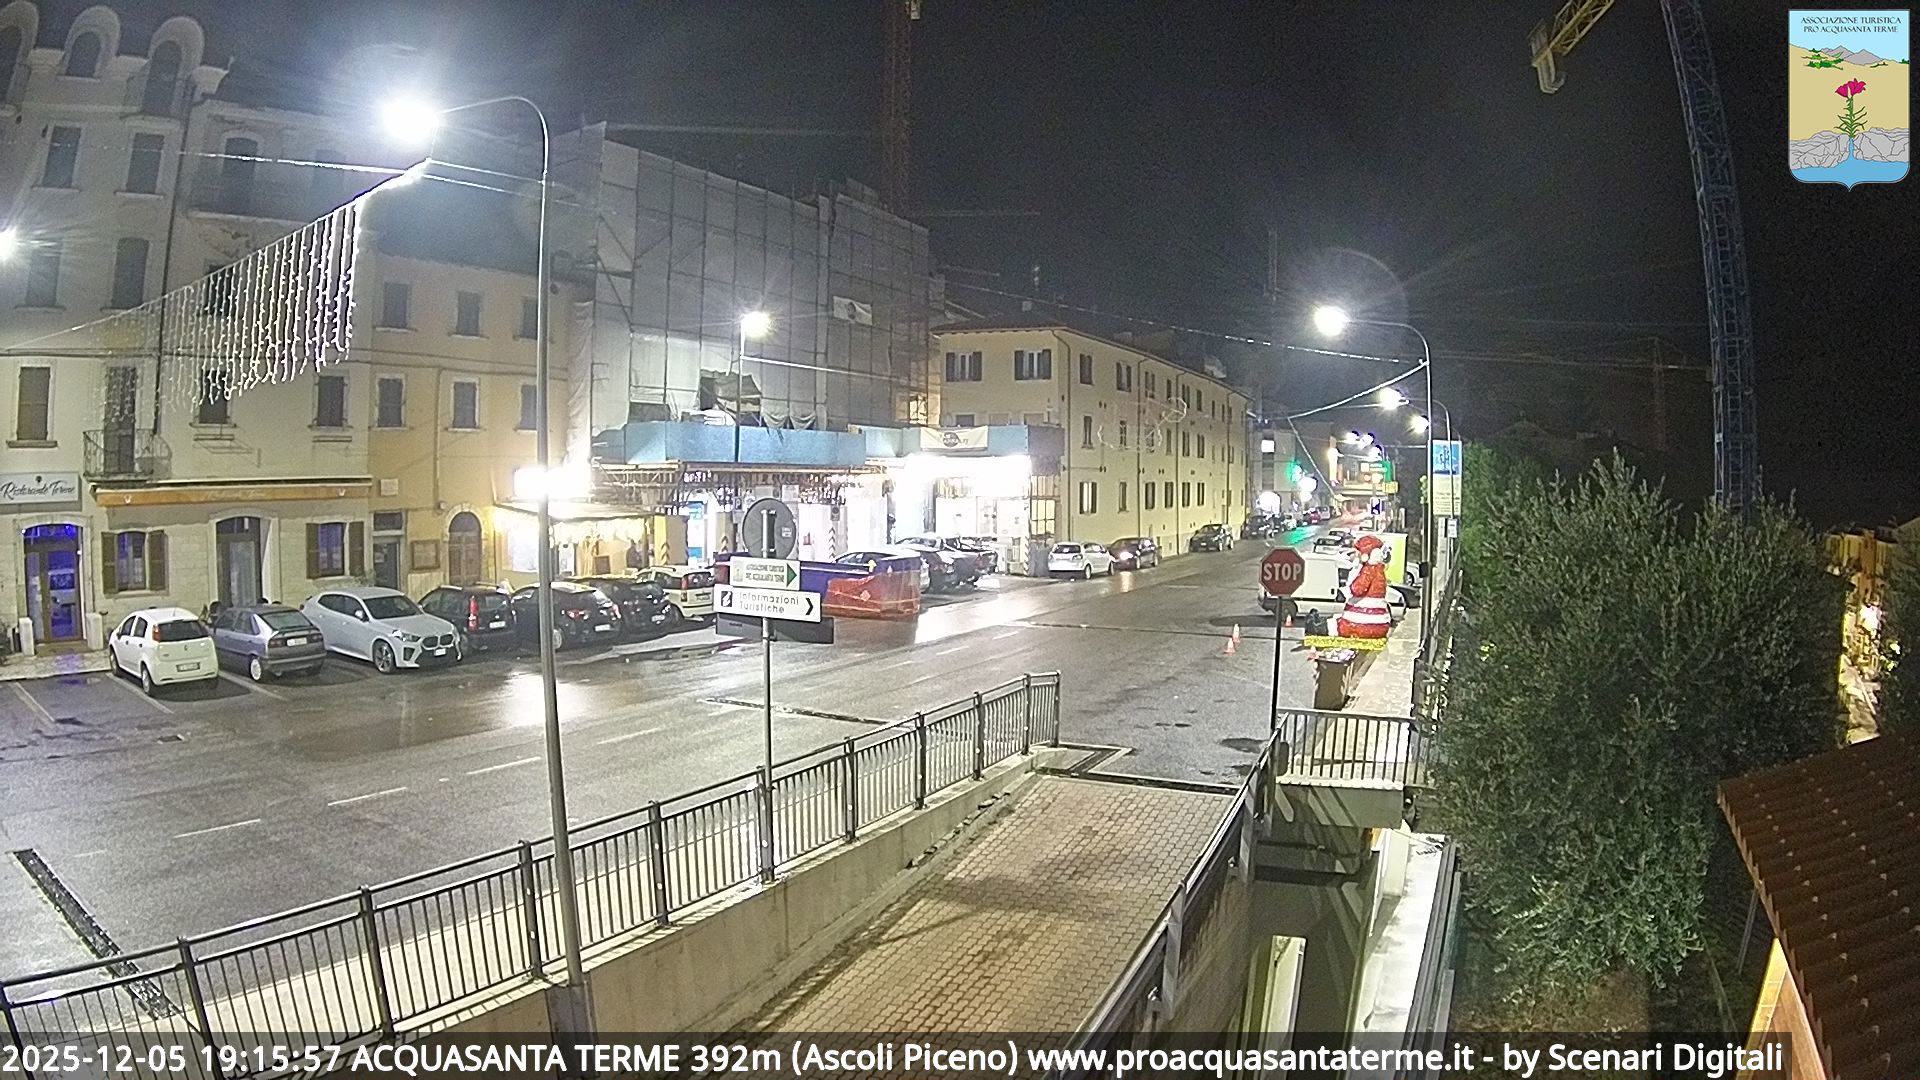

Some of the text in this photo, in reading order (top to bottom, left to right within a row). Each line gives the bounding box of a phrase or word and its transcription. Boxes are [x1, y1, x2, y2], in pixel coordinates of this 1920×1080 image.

[1263, 562, 1302, 581] STOP
[739, 592, 799, 606] Informazioni
[740, 600, 785, 614] Turistiche
